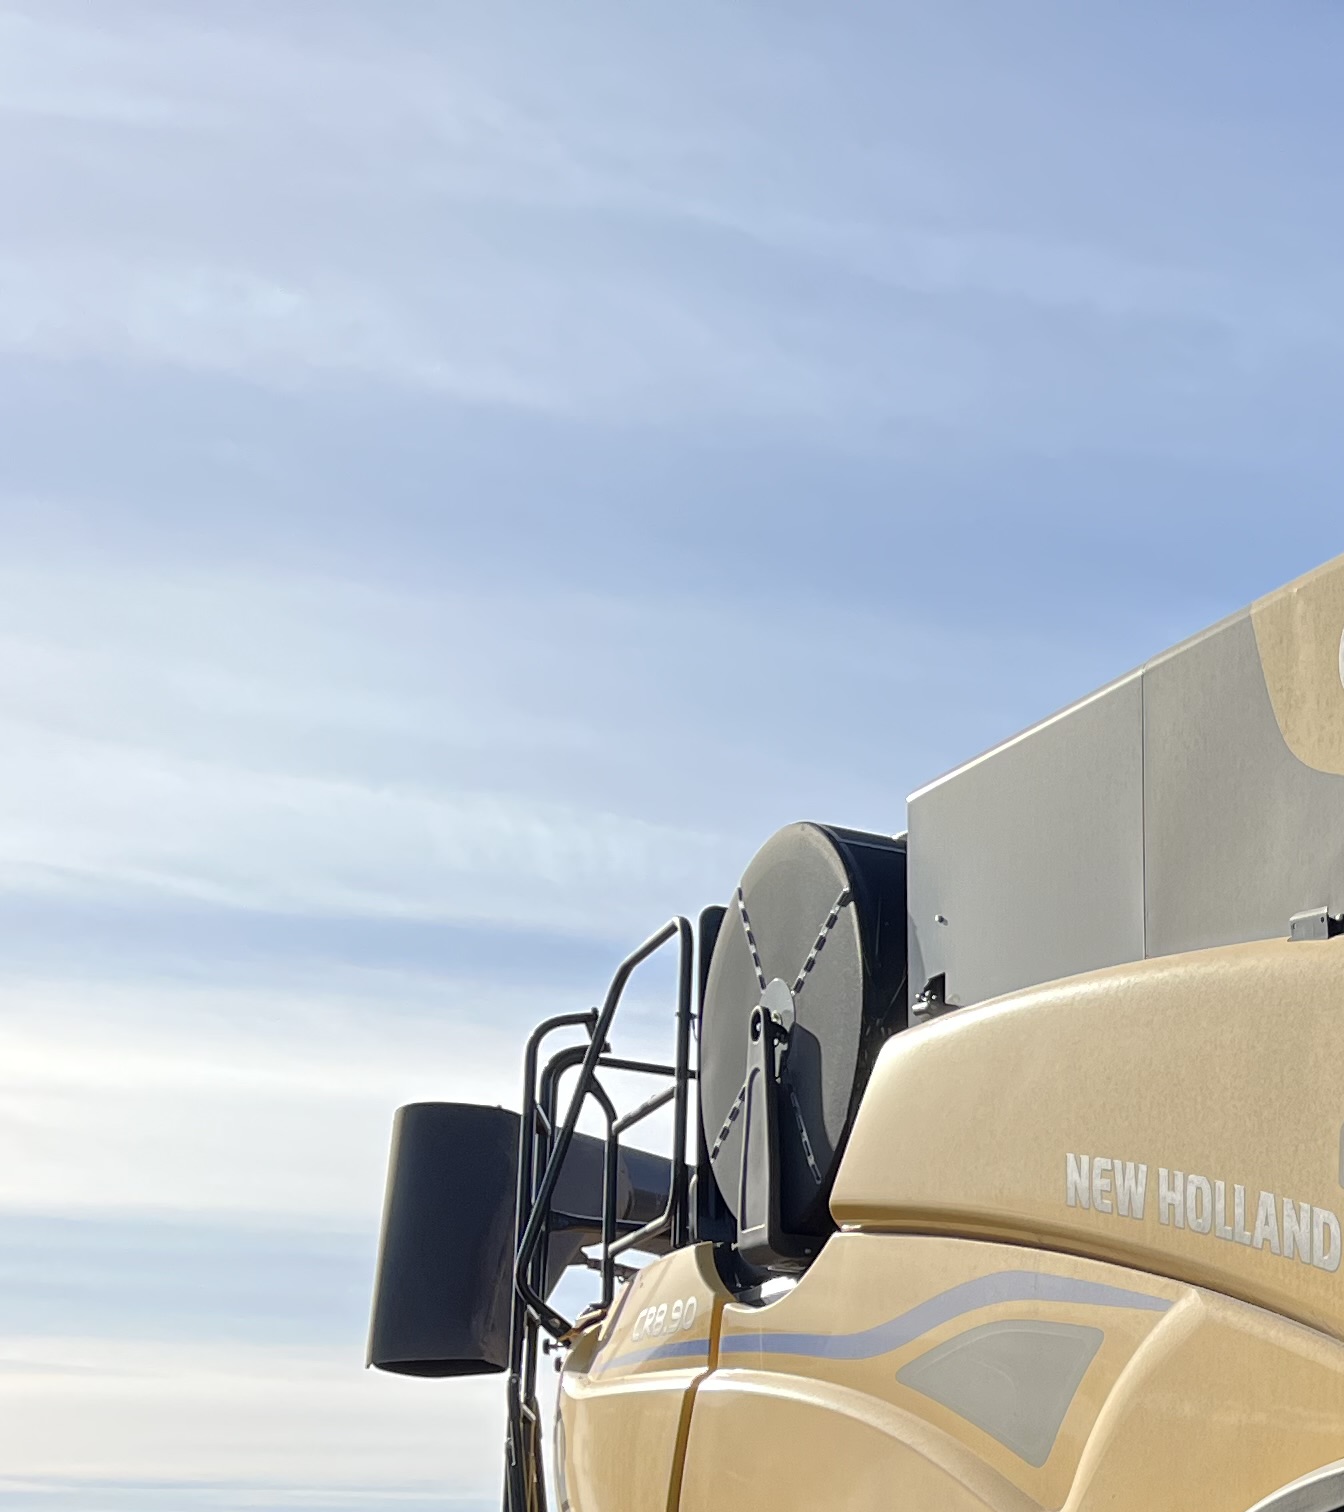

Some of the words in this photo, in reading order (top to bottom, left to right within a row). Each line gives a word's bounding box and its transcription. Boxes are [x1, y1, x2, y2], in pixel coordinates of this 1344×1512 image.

[1065, 1152, 1148, 1220] NEW
[1158, 1167, 1342, 1272] HOLLAND
[632, 1295, 698, 1342] CR8.90
